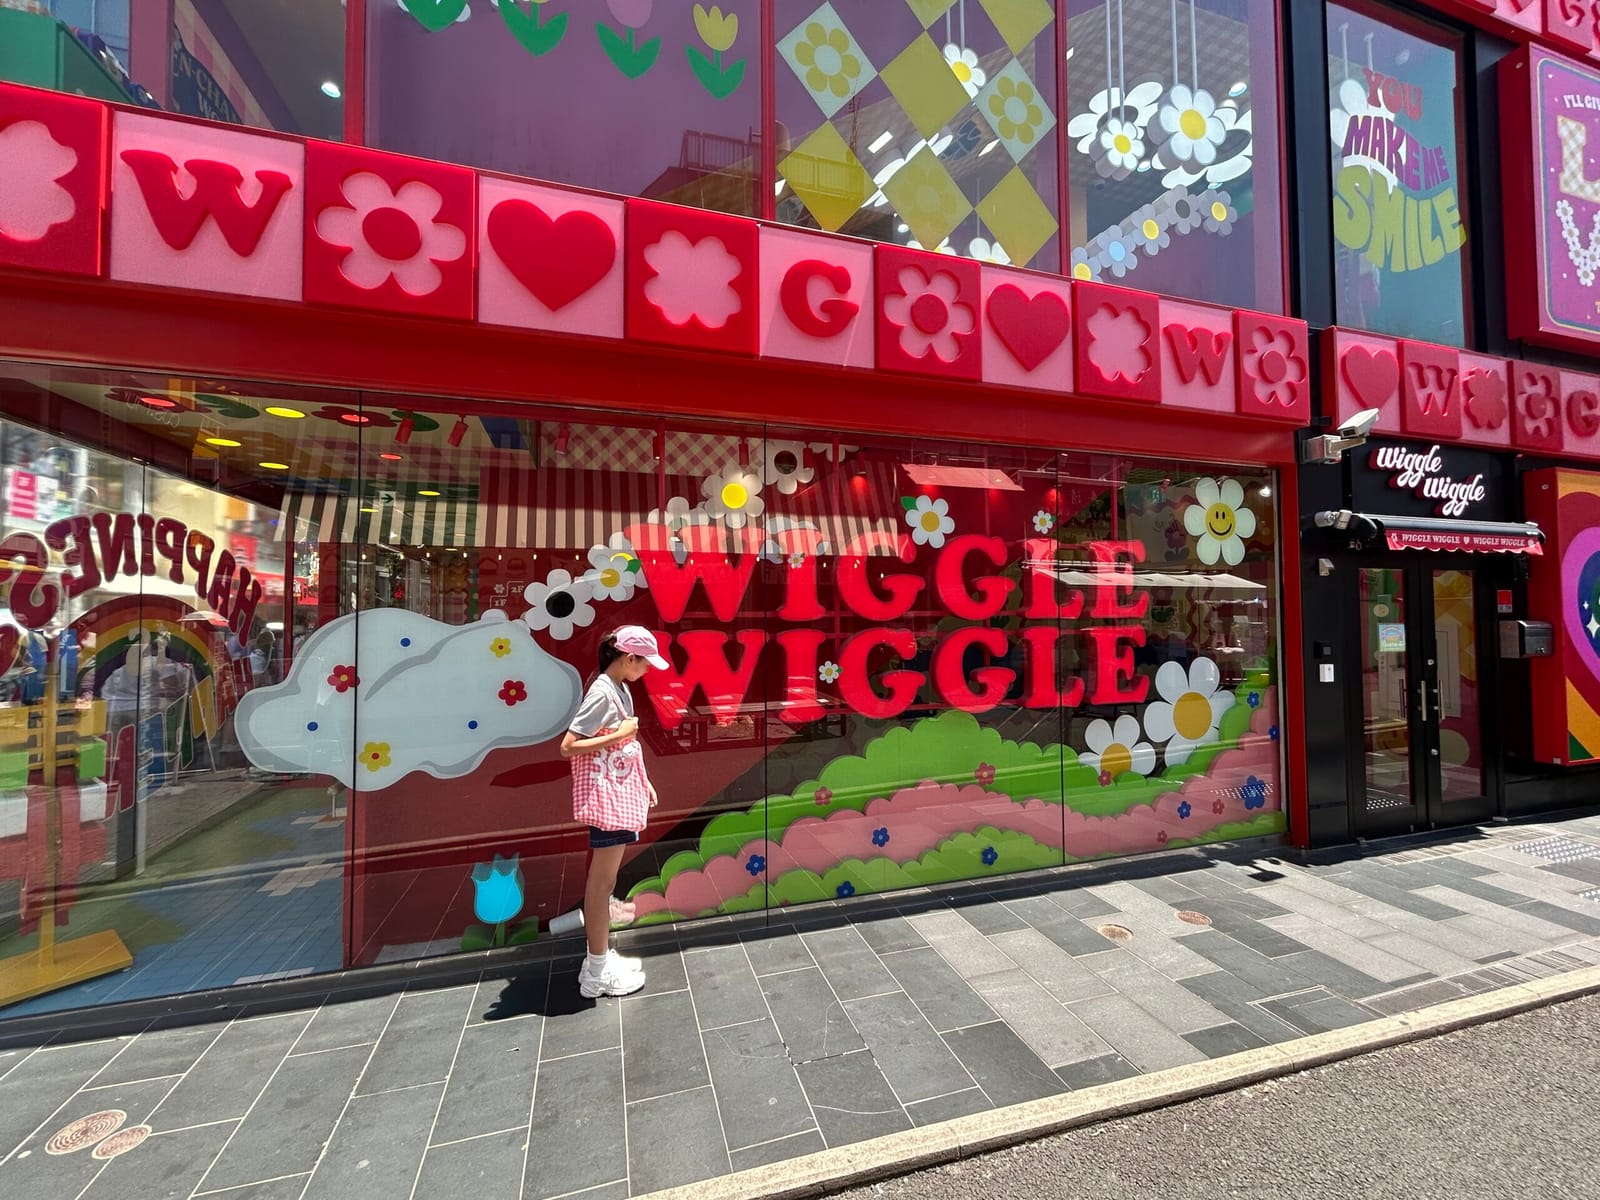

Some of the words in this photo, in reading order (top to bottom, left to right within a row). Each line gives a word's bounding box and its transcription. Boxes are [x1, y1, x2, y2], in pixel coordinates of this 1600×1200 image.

[1362, 66, 1423, 122] YOU
[1563, 94, 1585, 109] I'LL
[1342, 114, 1422, 191] MAKE
[1422, 145, 1450, 190] ME
[1333, 164, 1467, 273] SMILE
[120, 150, 293, 258] W
[780, 259, 860, 338] G
[1163, 323, 1234, 387] W
[1408, 361, 1458, 417] W
[623, 523, 1150, 624] WIGGLE
[1402, 533, 1432, 543] WIGGLE
[1433, 535, 1461, 545] WIGGLE
[1473, 537, 1500, 546] WIGGLE
[1500, 538, 1526, 547] WIGGLE
[641, 623, 1150, 730] WIGGLE
